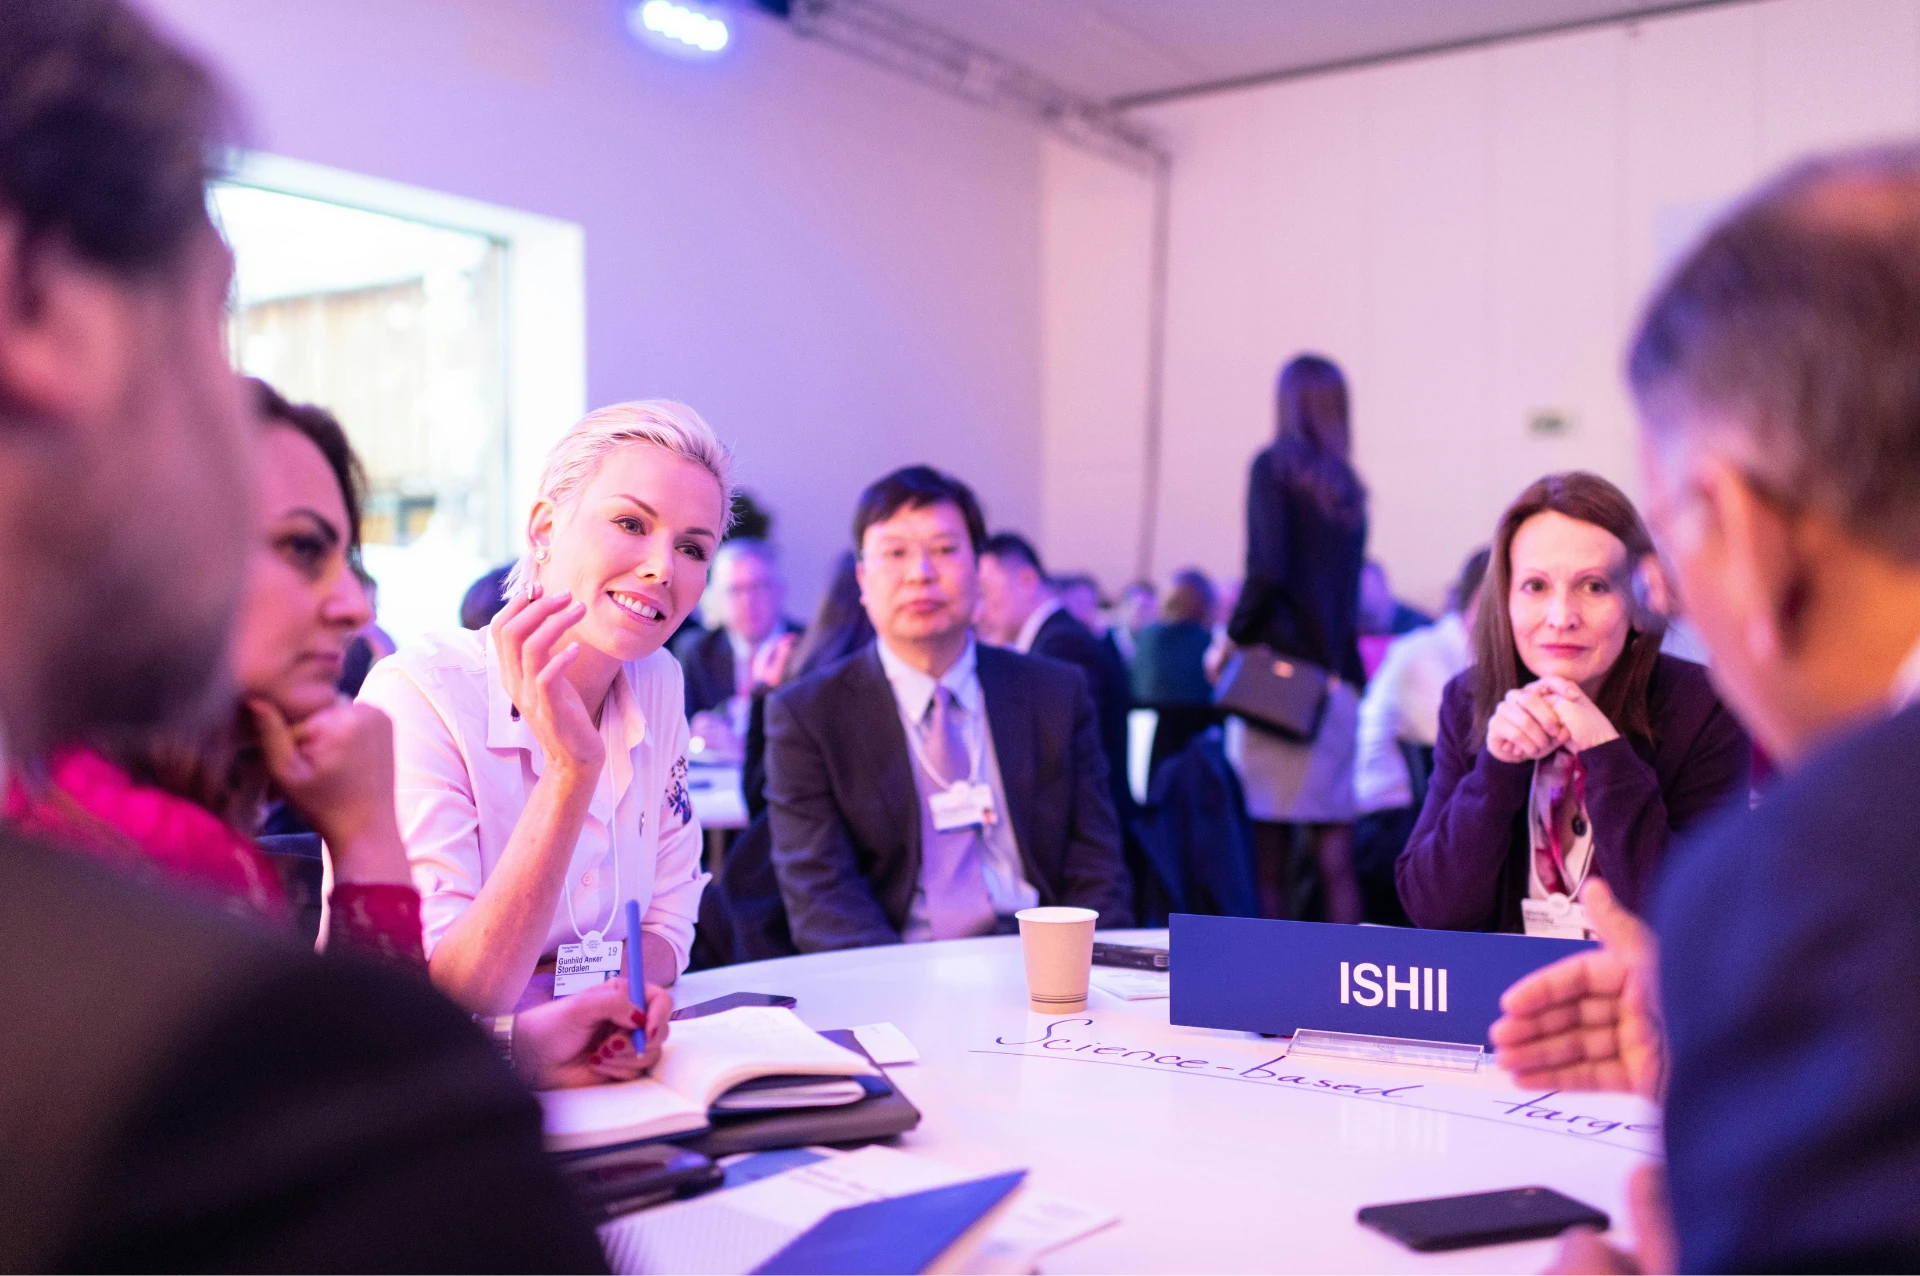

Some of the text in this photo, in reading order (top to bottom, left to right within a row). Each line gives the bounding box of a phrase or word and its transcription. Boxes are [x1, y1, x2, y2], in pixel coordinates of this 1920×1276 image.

[608, 946, 618, 957] 19
[558, 956, 603, 966] Gunhild Anker
[557, 964, 590, 974] Stordalen
[1340, 961, 1448, 1012] ISHII
